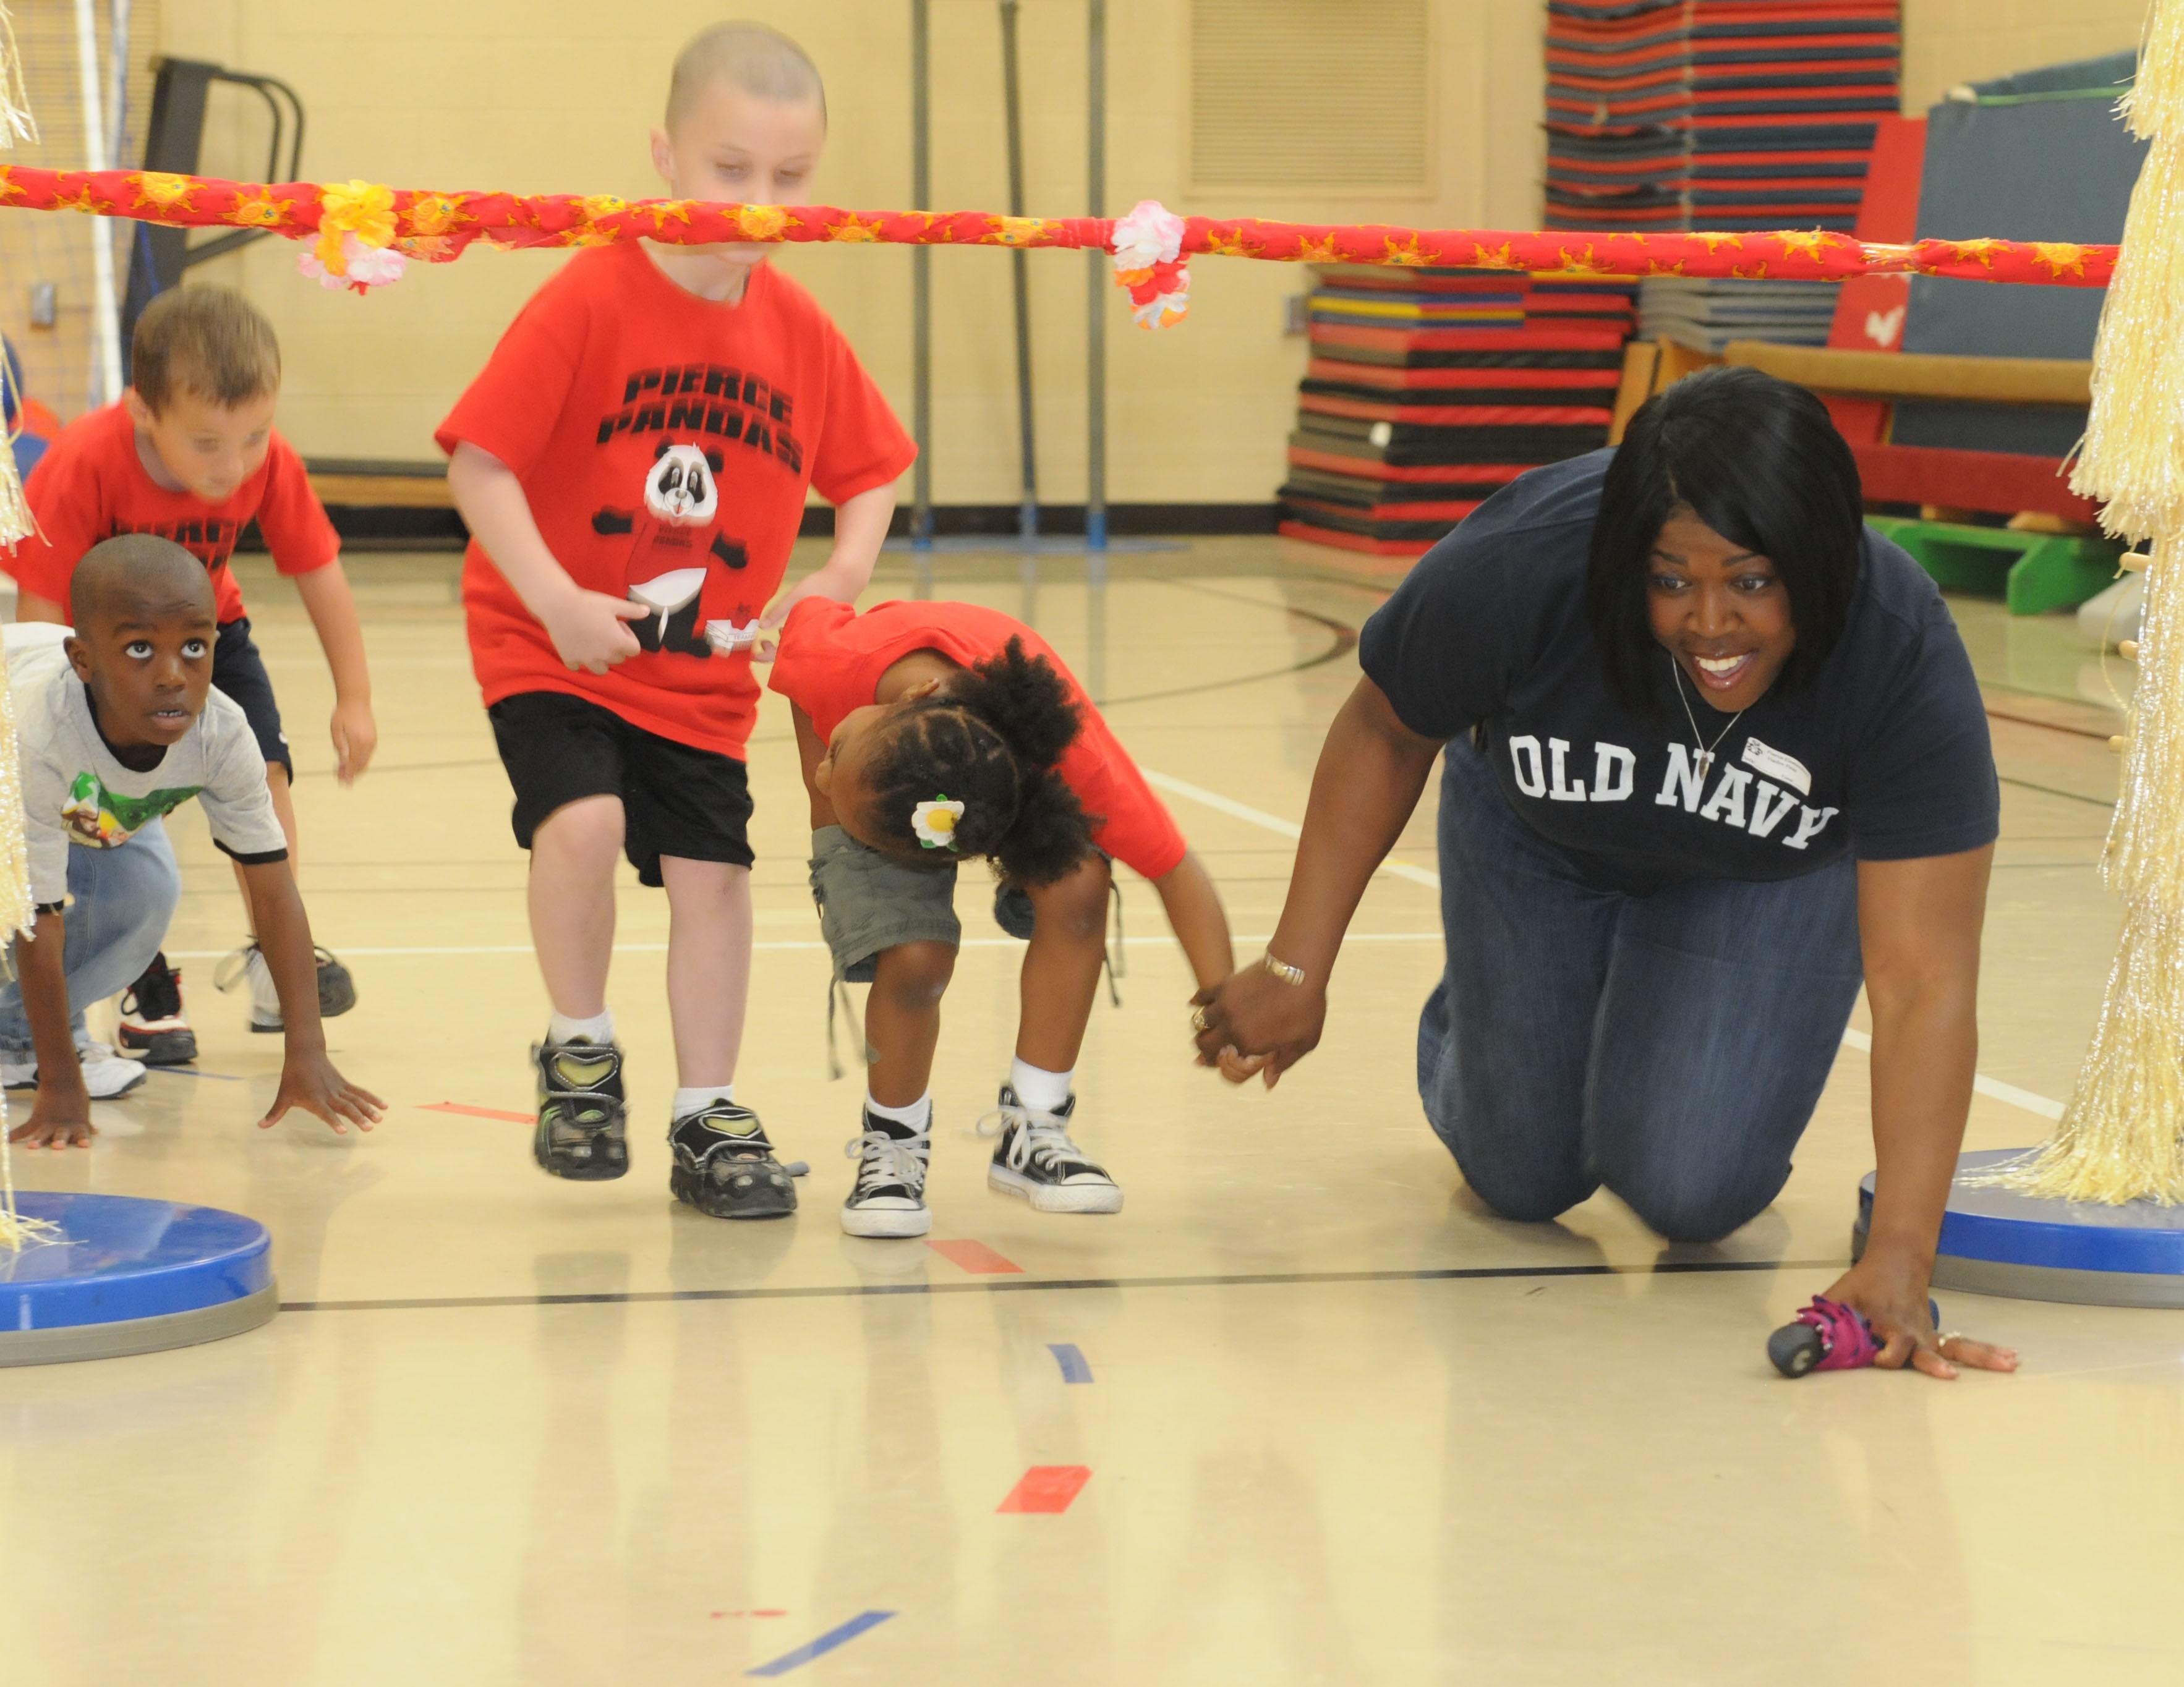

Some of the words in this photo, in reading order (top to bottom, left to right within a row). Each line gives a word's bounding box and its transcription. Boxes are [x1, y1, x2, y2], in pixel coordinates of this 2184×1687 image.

[623, 362, 792, 431] PIERCE
[596, 398, 803, 474] PANDAS
[1509, 735, 1636, 802] OLD
[1655, 742, 1840, 849] NAVY
